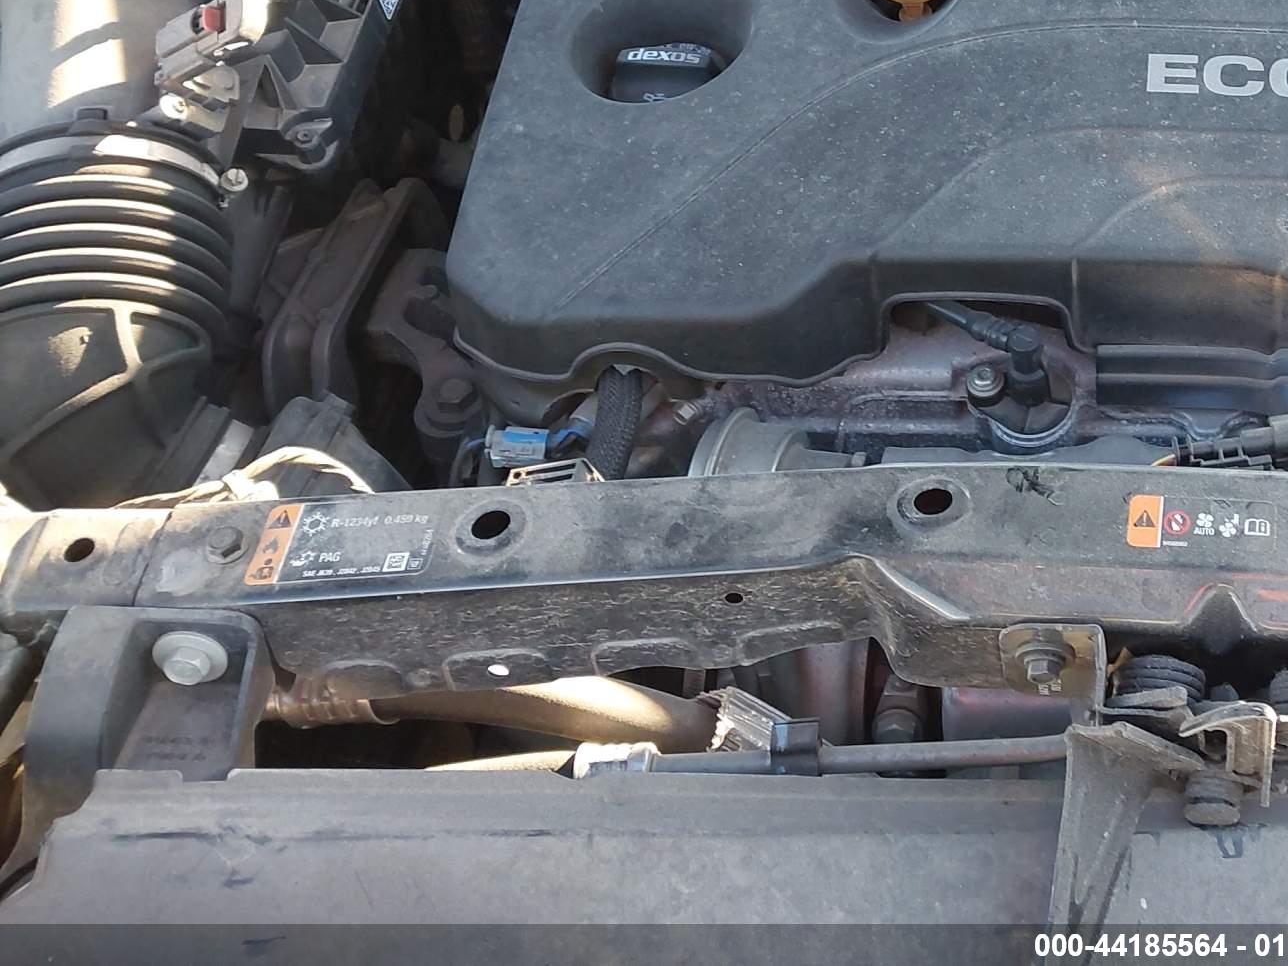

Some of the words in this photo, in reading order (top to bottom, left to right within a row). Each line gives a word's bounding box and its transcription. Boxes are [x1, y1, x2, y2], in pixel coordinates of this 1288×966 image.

[627, 48, 700, 63] dexos
[1193, 527, 1215, 536] AUTO
[318, 552, 342, 563] PAG
